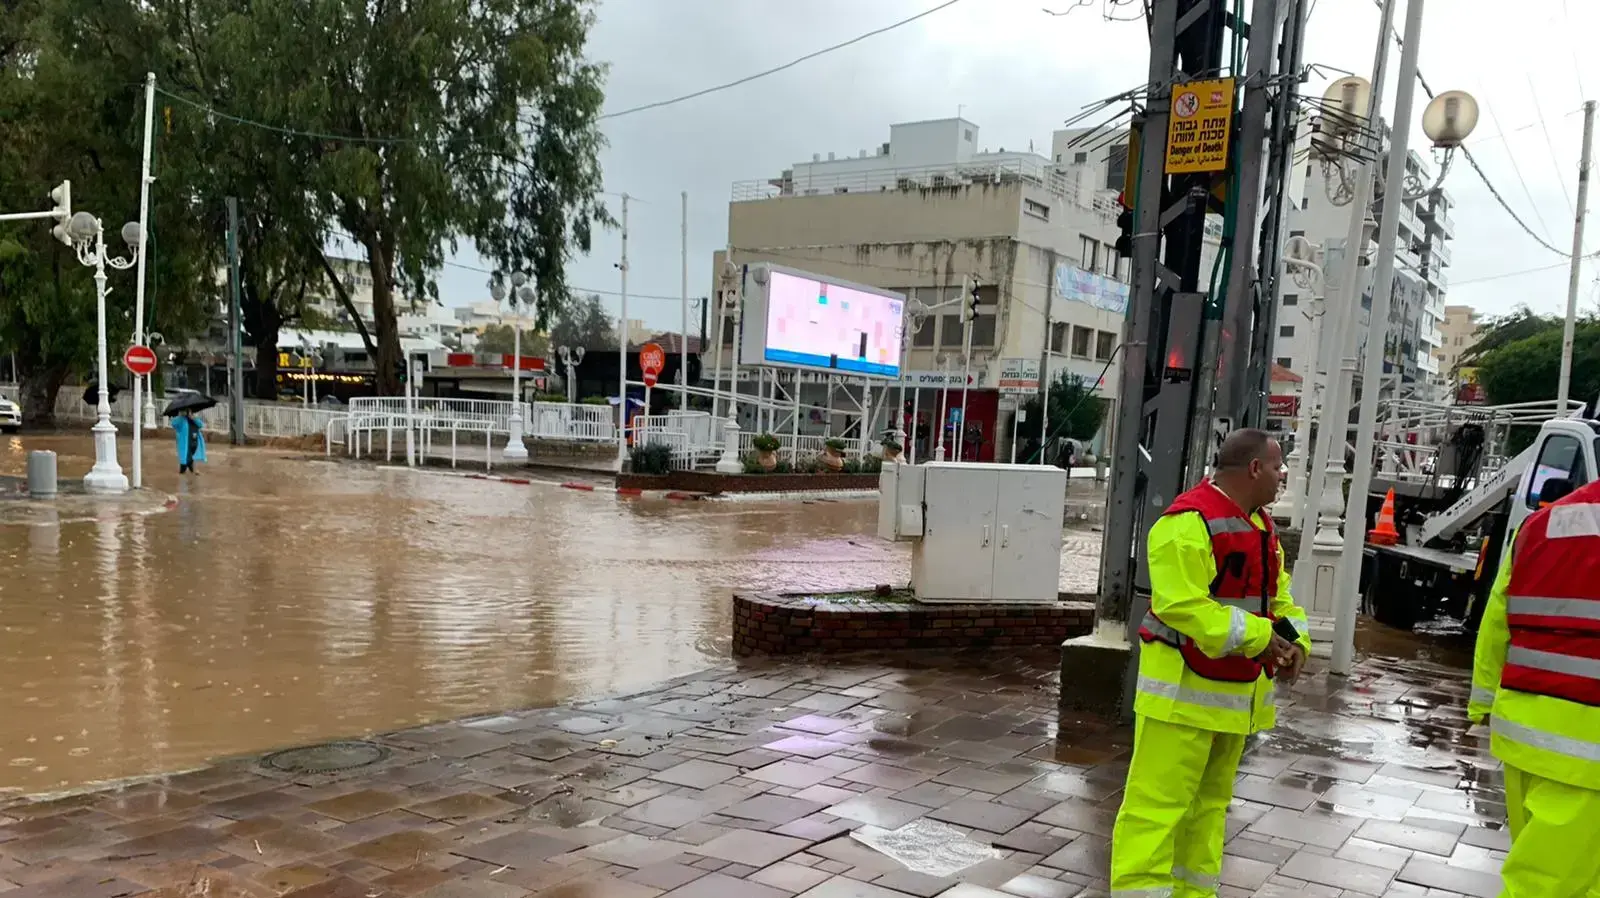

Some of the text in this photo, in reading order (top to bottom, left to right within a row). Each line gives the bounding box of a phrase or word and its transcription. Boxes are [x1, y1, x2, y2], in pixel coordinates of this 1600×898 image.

[1172, 117, 1226, 131] מתח גבוה!
[1171, 130, 1225, 143] סכנת מוות!
[1170, 141, 1224, 156] Danger of Death!
